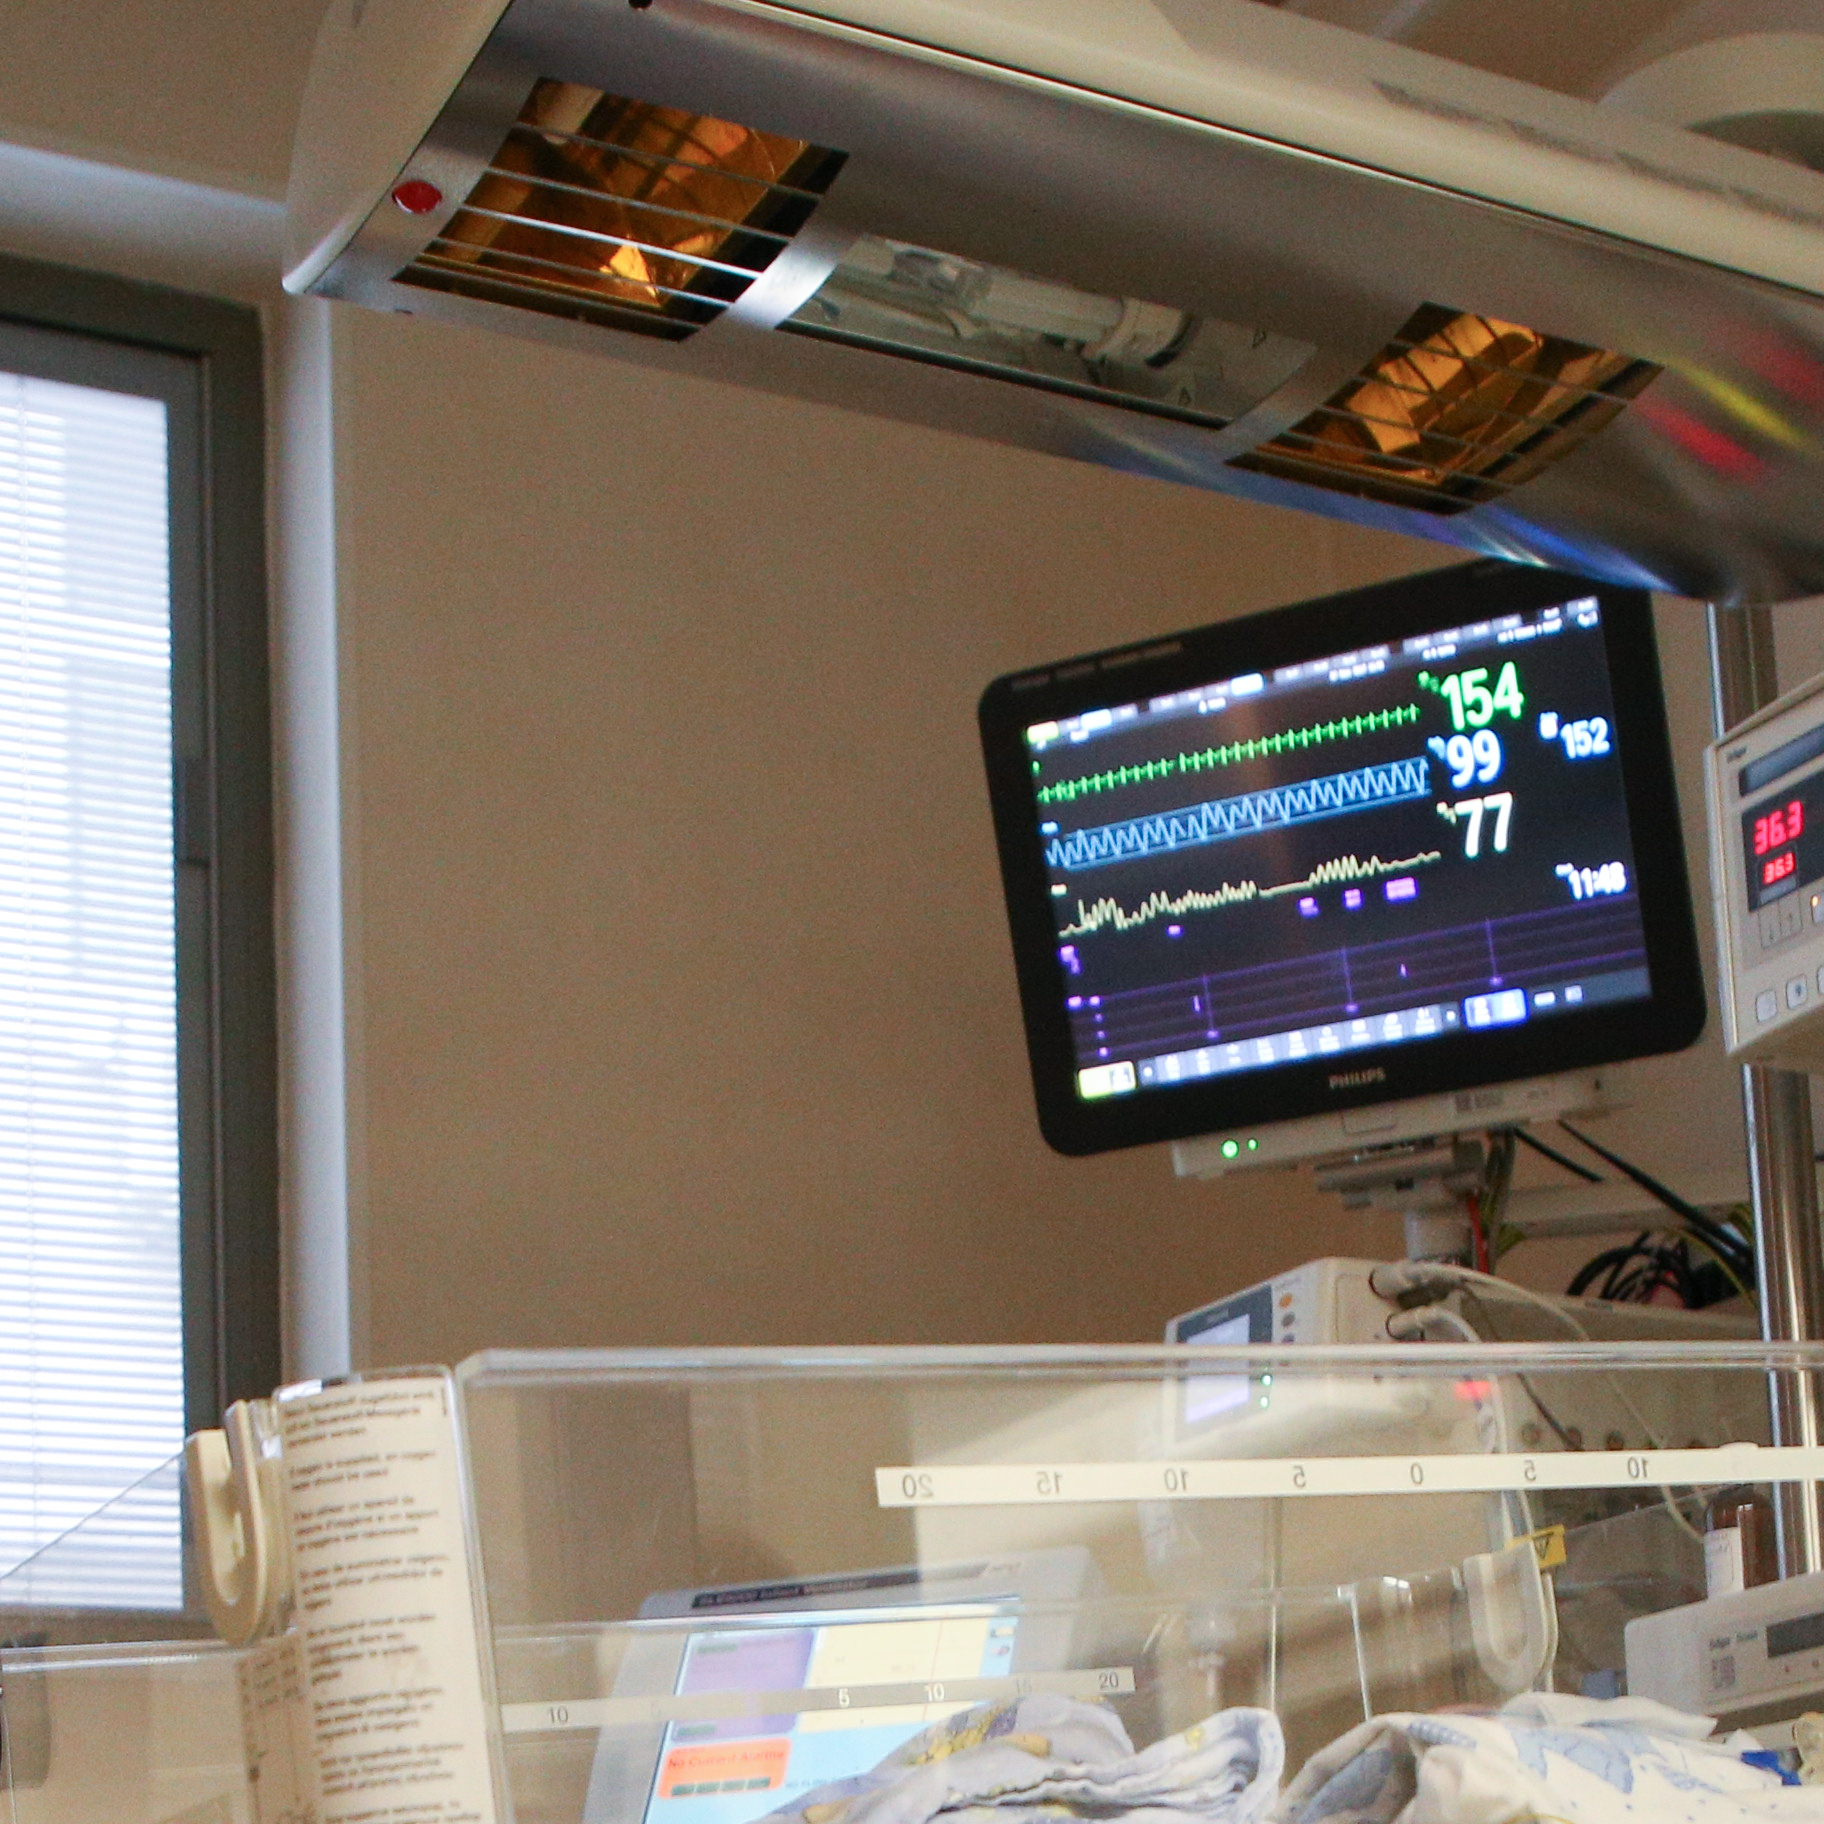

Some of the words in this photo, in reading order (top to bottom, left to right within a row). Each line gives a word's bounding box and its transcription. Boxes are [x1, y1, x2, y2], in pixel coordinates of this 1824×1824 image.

[1442, 660, 1526, 733] 154
[1446, 728, 1502, 790] 99
[1560, 716, 1611, 762] 152
[1457, 791, 1515, 859] 77
[1752, 799, 1806, 857] 36.3
[1567, 861, 1628, 901] 11:48
[1328, 1066, 1387, 1091] PHILIPS
[547, 1704, 570, 1726] 10
[837, 1688, 850, 1708] 5
[924, 1683, 946, 1704] 10
[1098, 1671, 1120, 1692] 20
